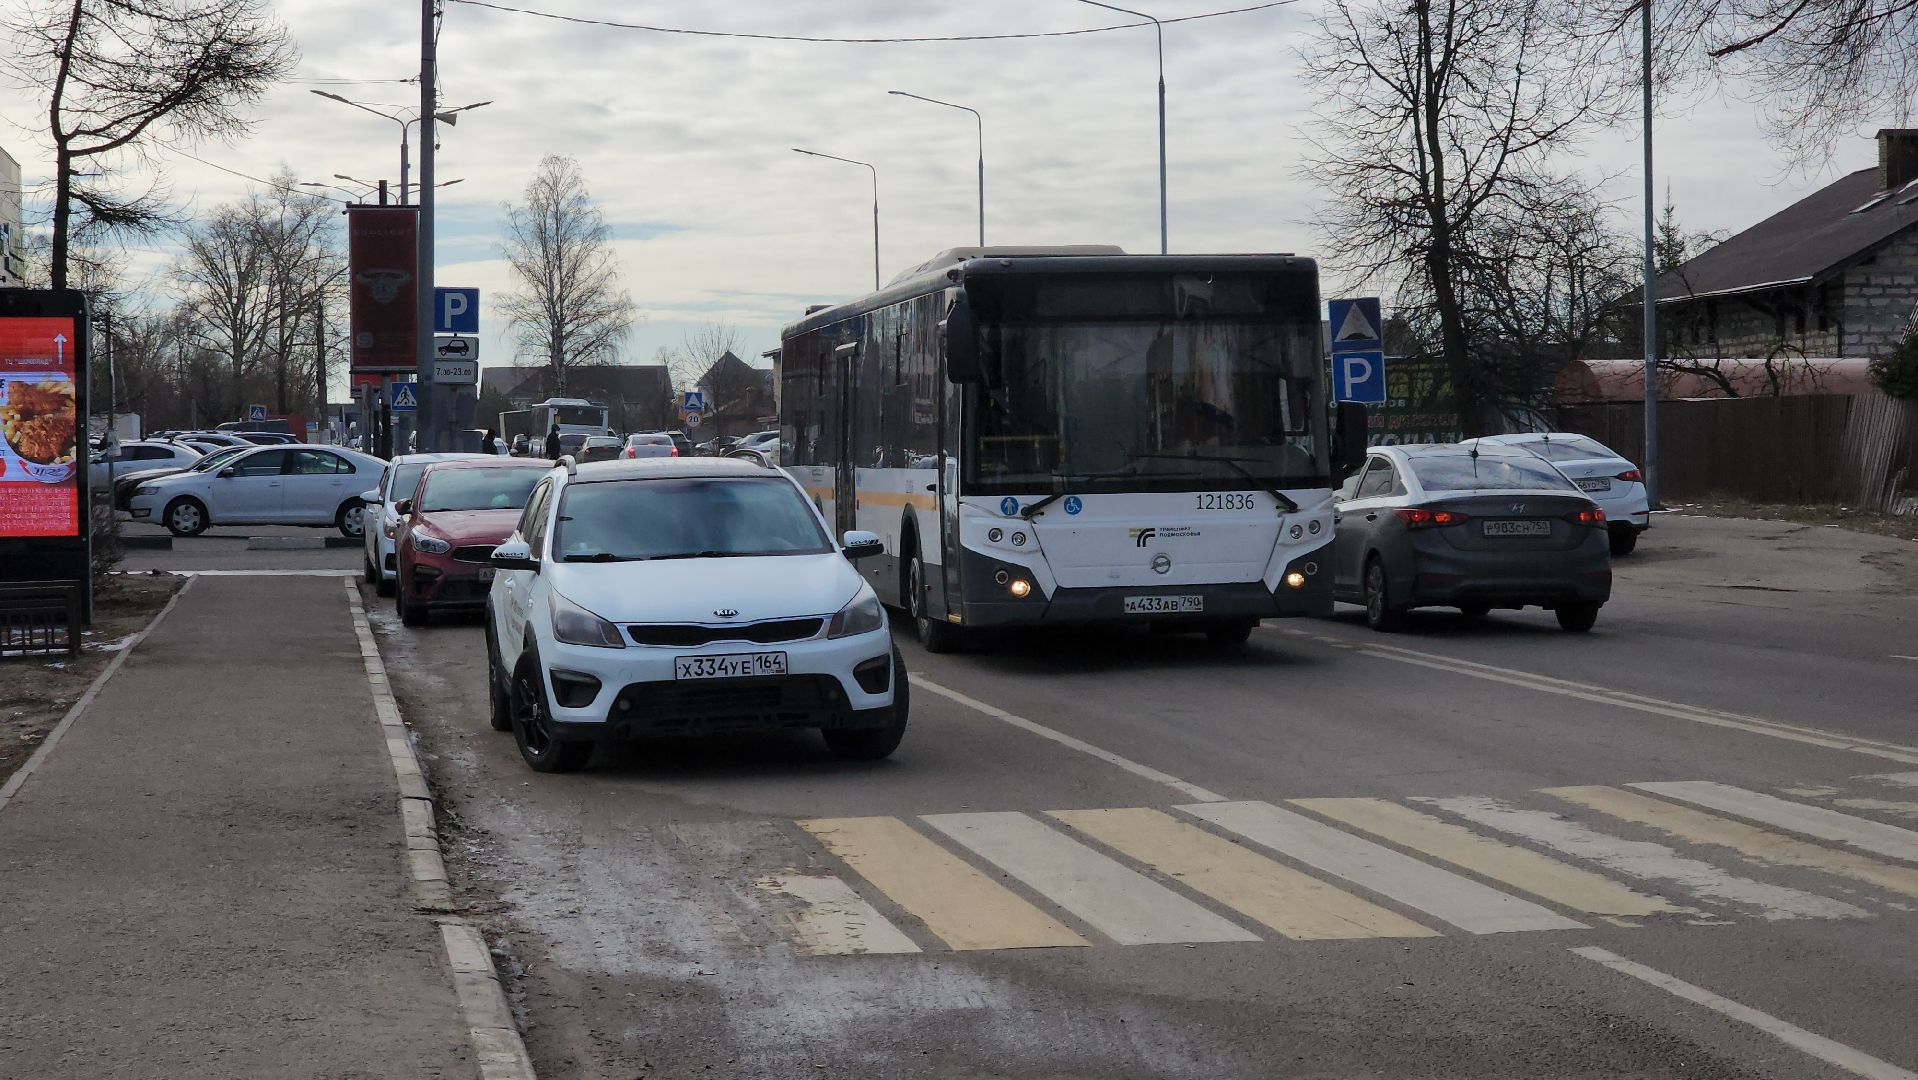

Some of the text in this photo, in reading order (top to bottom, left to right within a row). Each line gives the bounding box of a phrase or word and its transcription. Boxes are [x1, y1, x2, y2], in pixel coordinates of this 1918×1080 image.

[444, 292, 468, 329] P
[1343, 357, 1373, 398] P
[688, 415, 699, 423] 20
[1196, 493, 1254, 510] 121836
[1129, 596, 1201, 611] А433АВ 790
[682, 654, 782, 678] Х334УЕ 164
